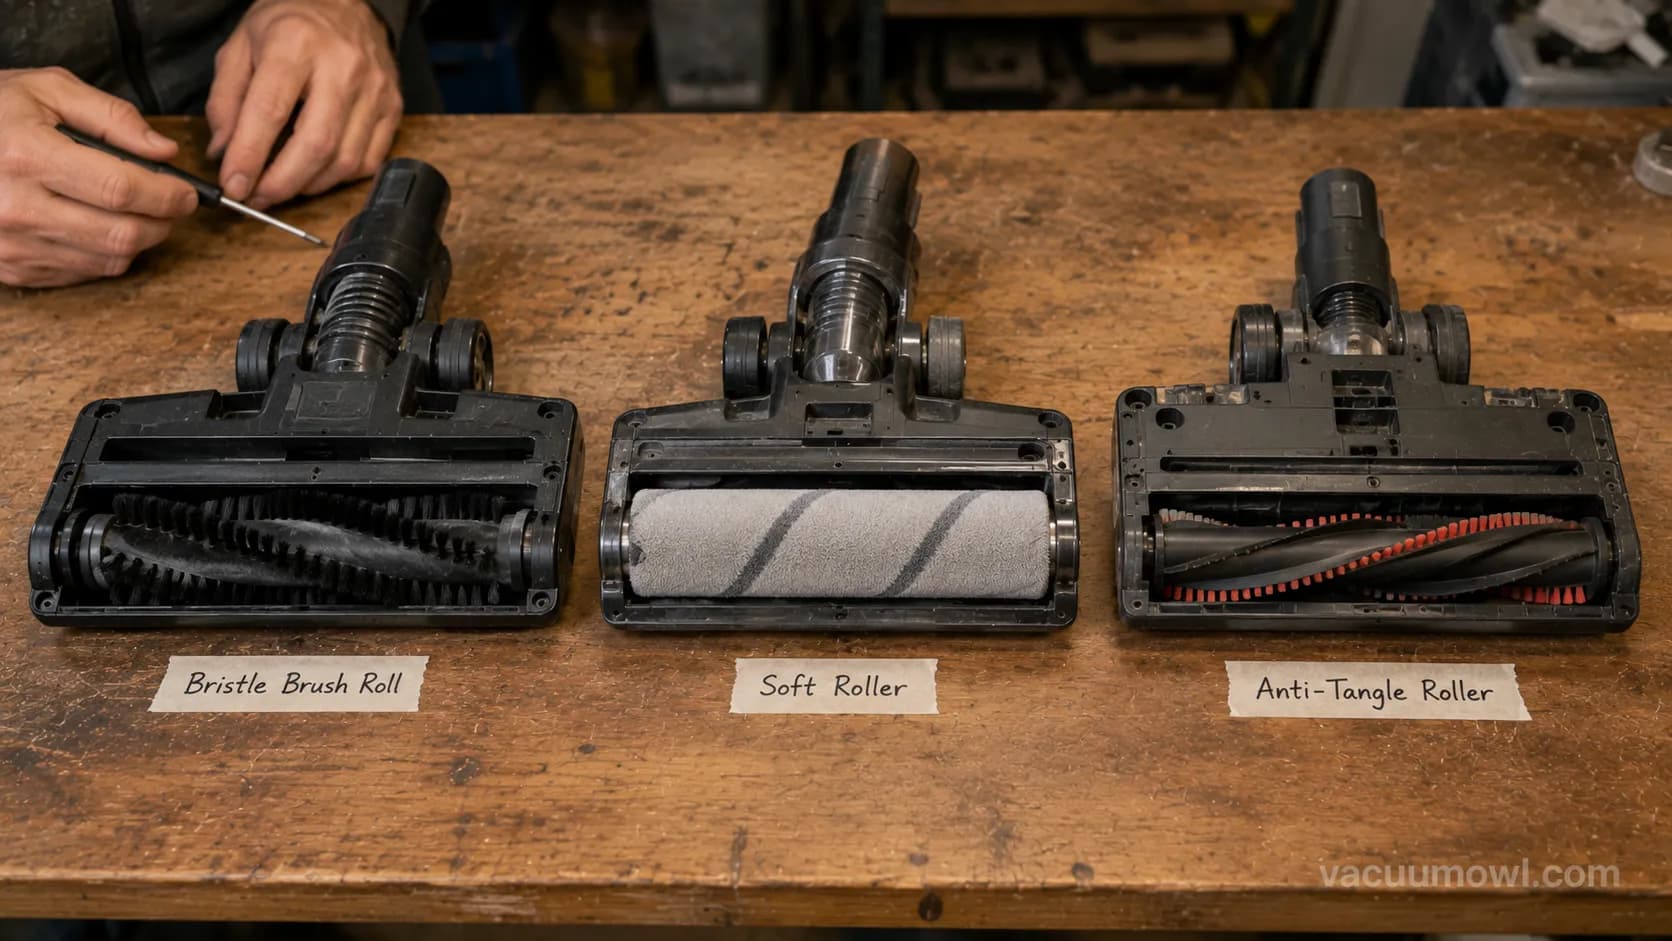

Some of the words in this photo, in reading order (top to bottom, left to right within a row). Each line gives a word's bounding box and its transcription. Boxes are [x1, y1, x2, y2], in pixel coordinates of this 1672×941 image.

[184, 672, 267, 694] Bristle
[281, 672, 348, 694] Brush
[359, 672, 402, 694] Roll
[759, 673, 817, 697] Soft
[834, 674, 908, 697] Roller
[1256, 676, 1407, 710] Anti-Tangle
[1421, 679, 1494, 701] Roller
